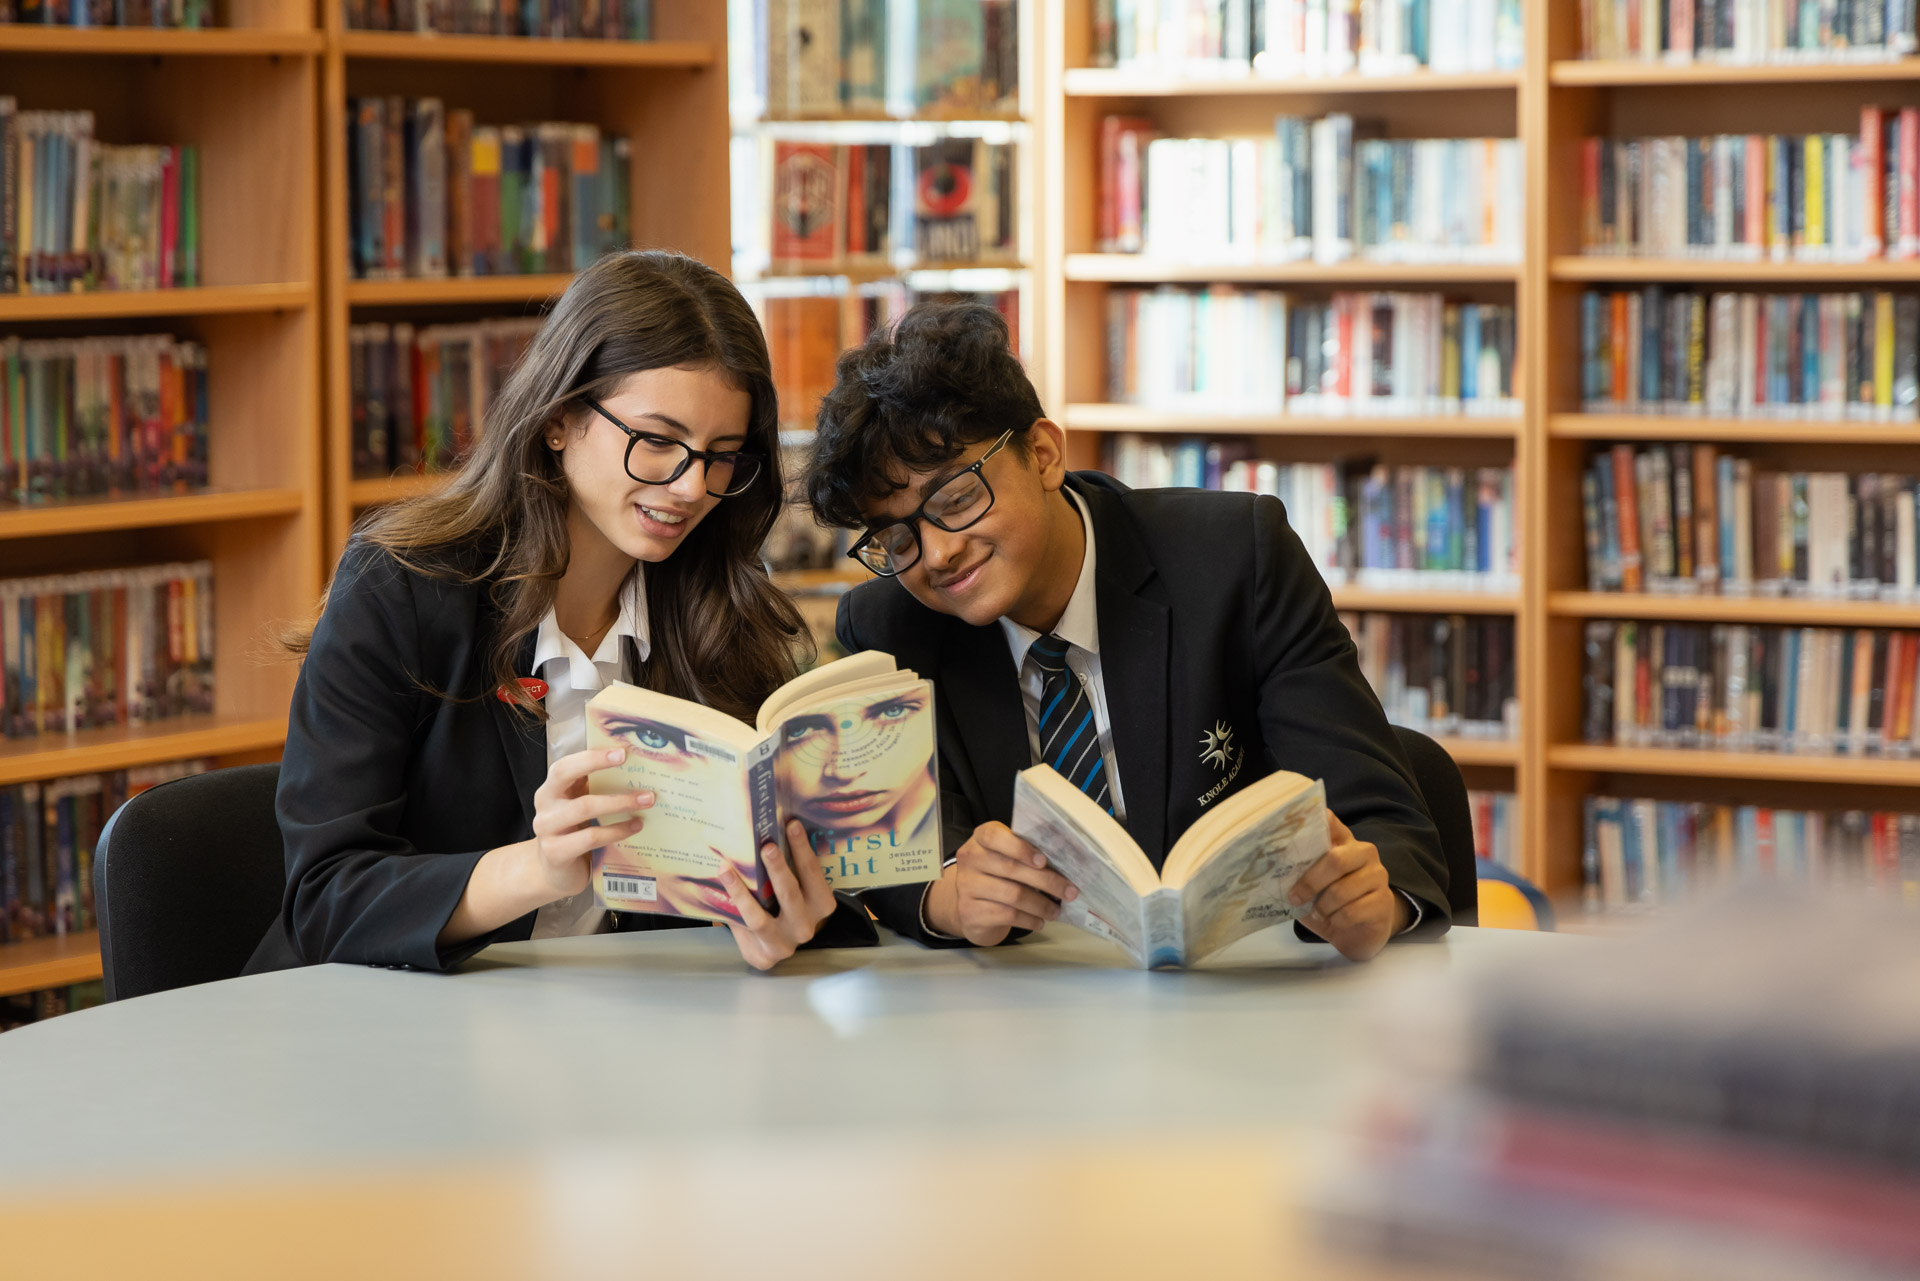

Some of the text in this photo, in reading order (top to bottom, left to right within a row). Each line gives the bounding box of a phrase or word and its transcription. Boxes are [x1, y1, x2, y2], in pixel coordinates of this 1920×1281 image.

[627, 765, 645, 773] girl
[627, 780, 634, 788] A
[758, 769, 773, 806] first
[1197, 777, 1229, 807] KNOLE
[810, 827, 902, 857] first
[888, 848, 934, 860] jennifer
[900, 857, 923, 866] lynn
[895, 864, 929, 873] barnes
